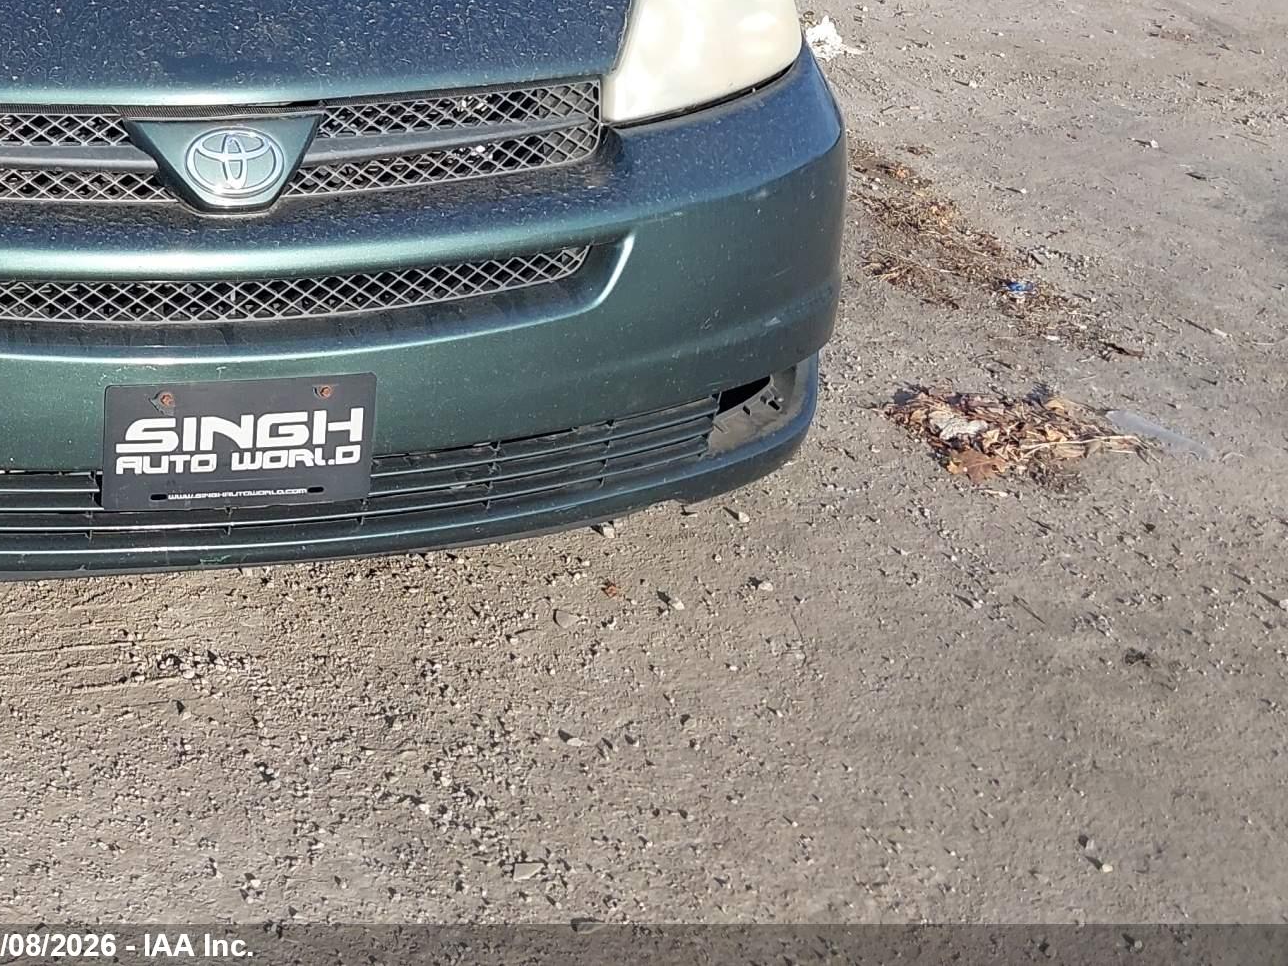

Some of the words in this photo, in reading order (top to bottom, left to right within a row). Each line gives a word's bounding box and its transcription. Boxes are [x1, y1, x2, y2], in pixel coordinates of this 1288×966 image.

[115, 407, 365, 453] SINGH
[115, 453, 218, 475] AUTO
[231, 444, 361, 471] WORLD
